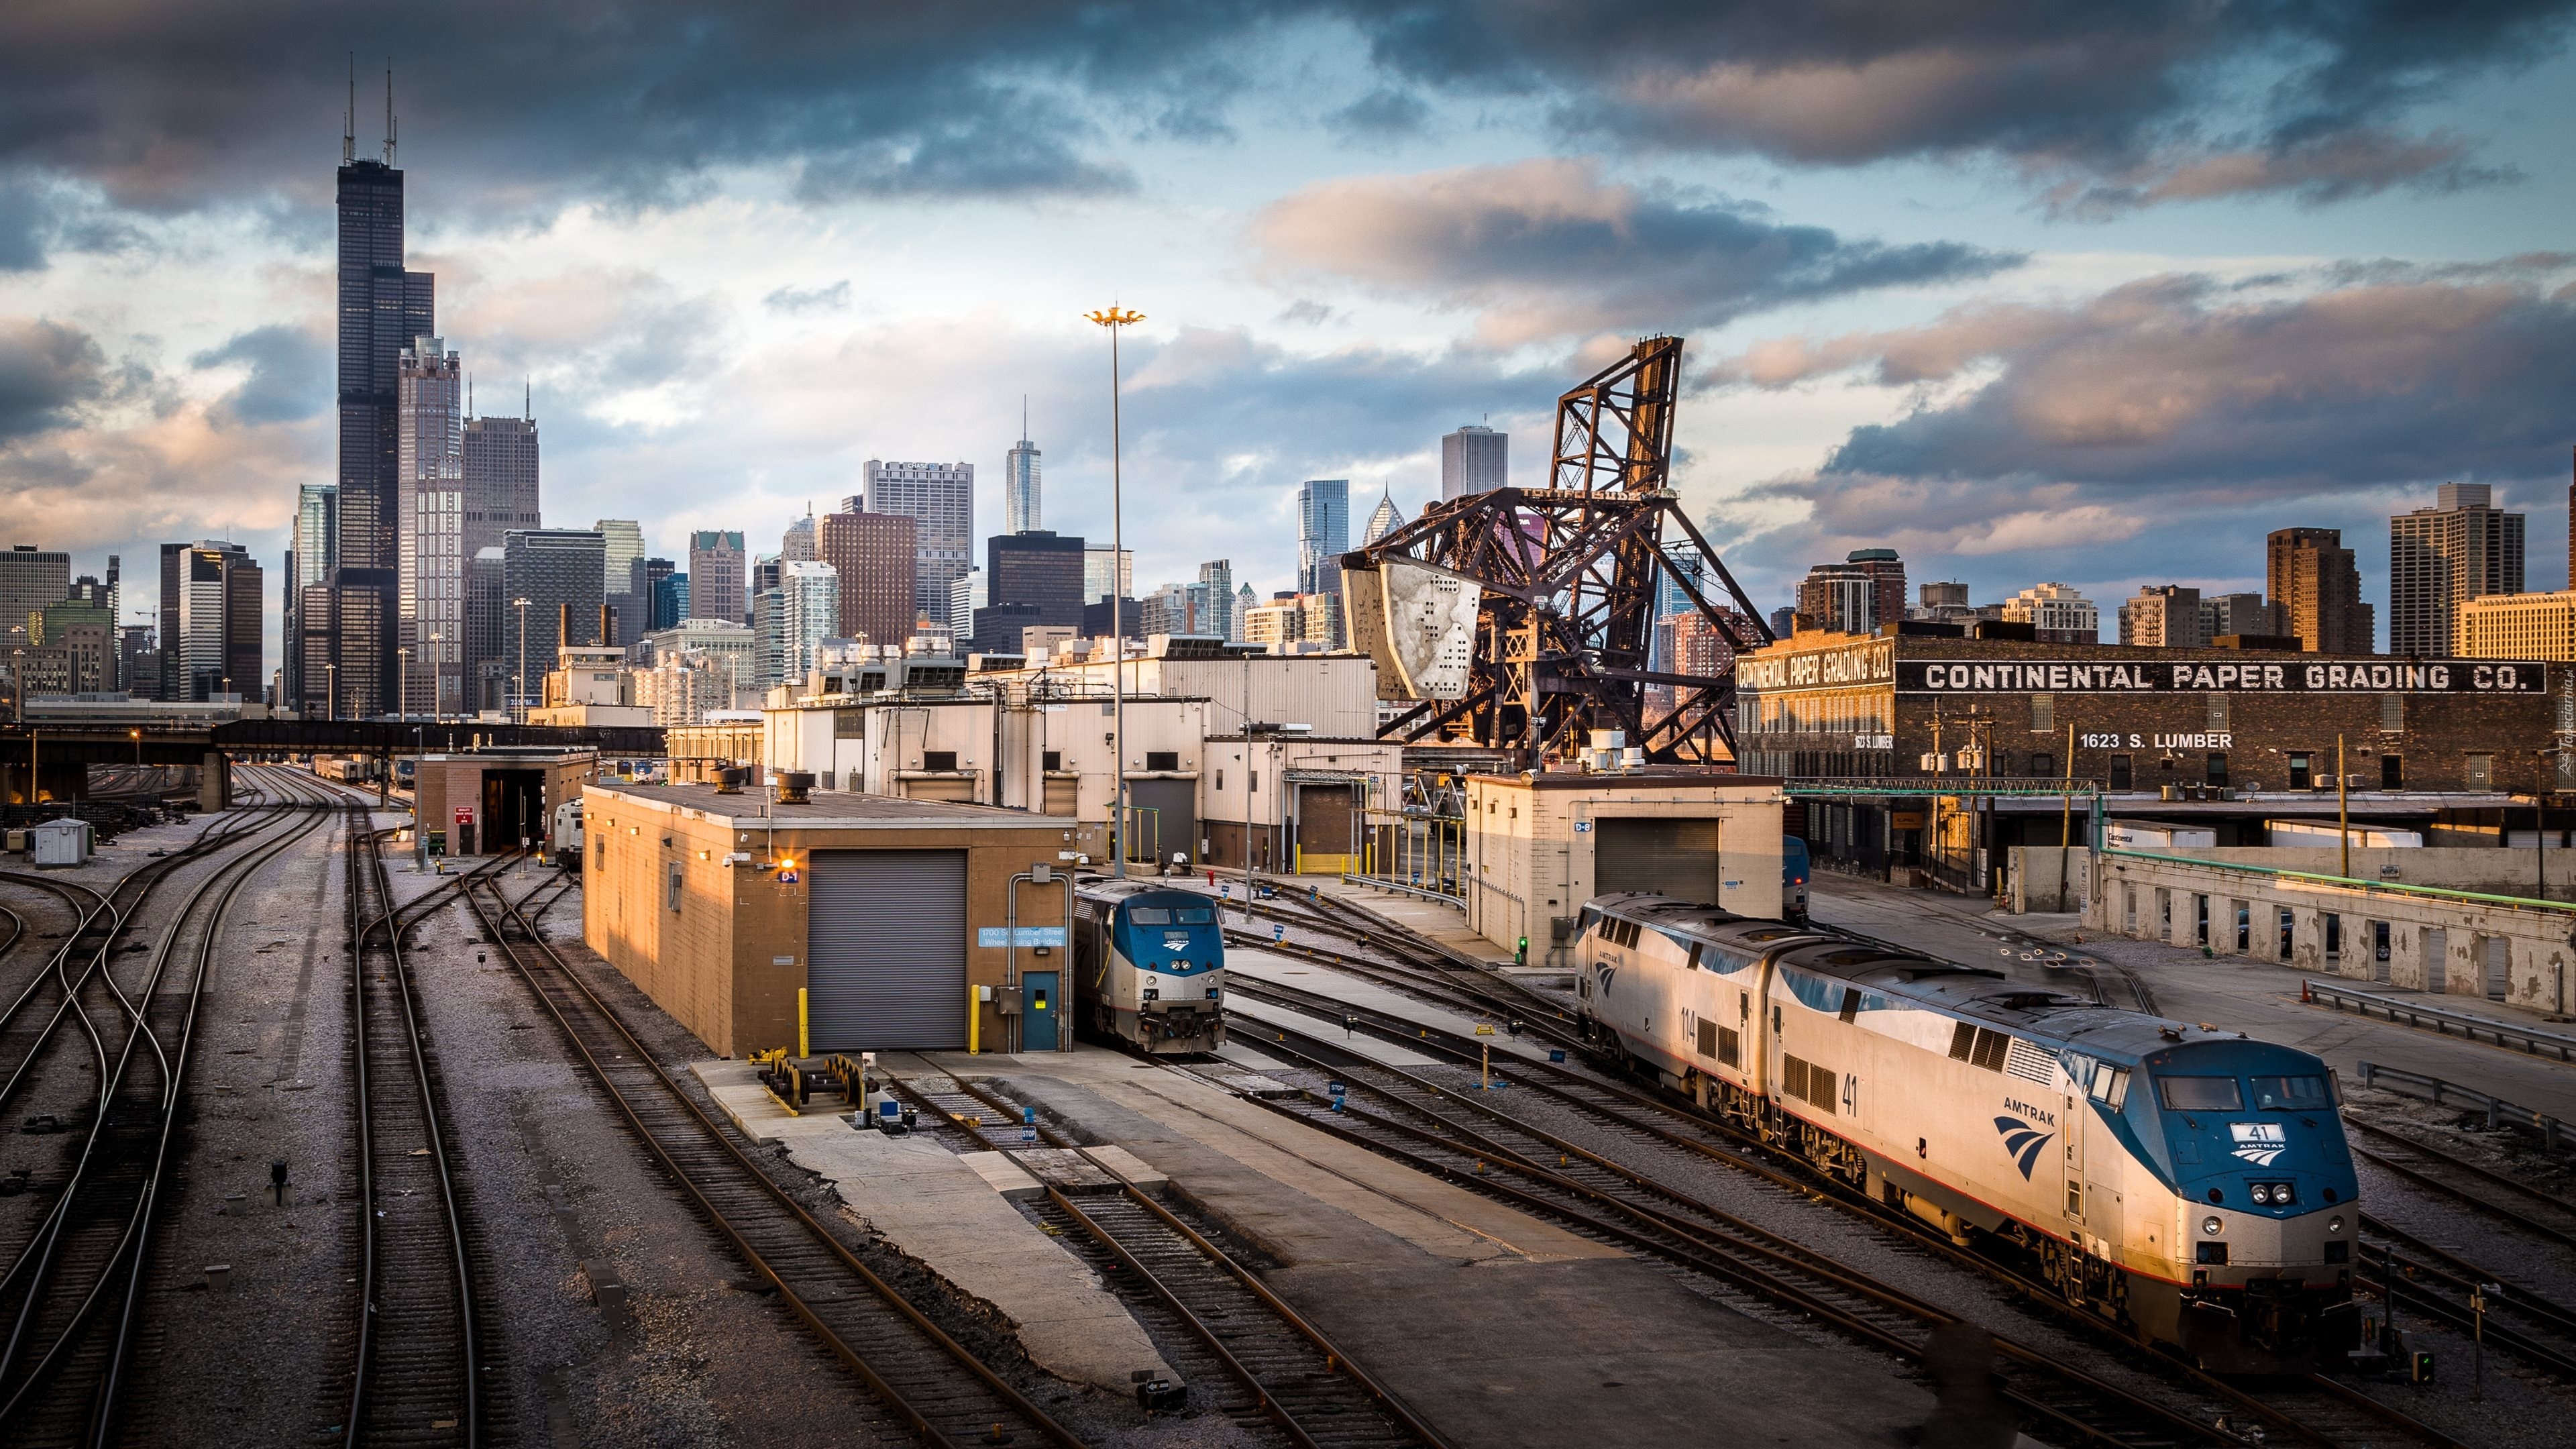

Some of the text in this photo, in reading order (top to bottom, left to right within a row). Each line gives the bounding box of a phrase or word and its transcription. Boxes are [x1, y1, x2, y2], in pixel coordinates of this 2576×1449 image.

[1739, 645, 1891, 688] CONTINENTAL PAPER GRADING CO.
[1926, 664, 2528, 690] CONTINENTAL PAPER GRADING CO.
[1854, 735, 1893, 749] 1623 S. LUMBER
[2080, 733, 2233, 749] 1623 S. LUMBER
[782, 872, 798, 881] D-1
[1033, 938, 1062, 946] Building
[1599, 950, 1618, 964] AMTRAK
[1681, 1006, 1695, 1045] 114
[1842, 1073, 1857, 1118] 41
[2004, 1096, 2055, 1127] AMTRAK
[1022, 1130, 1035, 1138] STOP
[2249, 1126, 2269, 1140] 41
